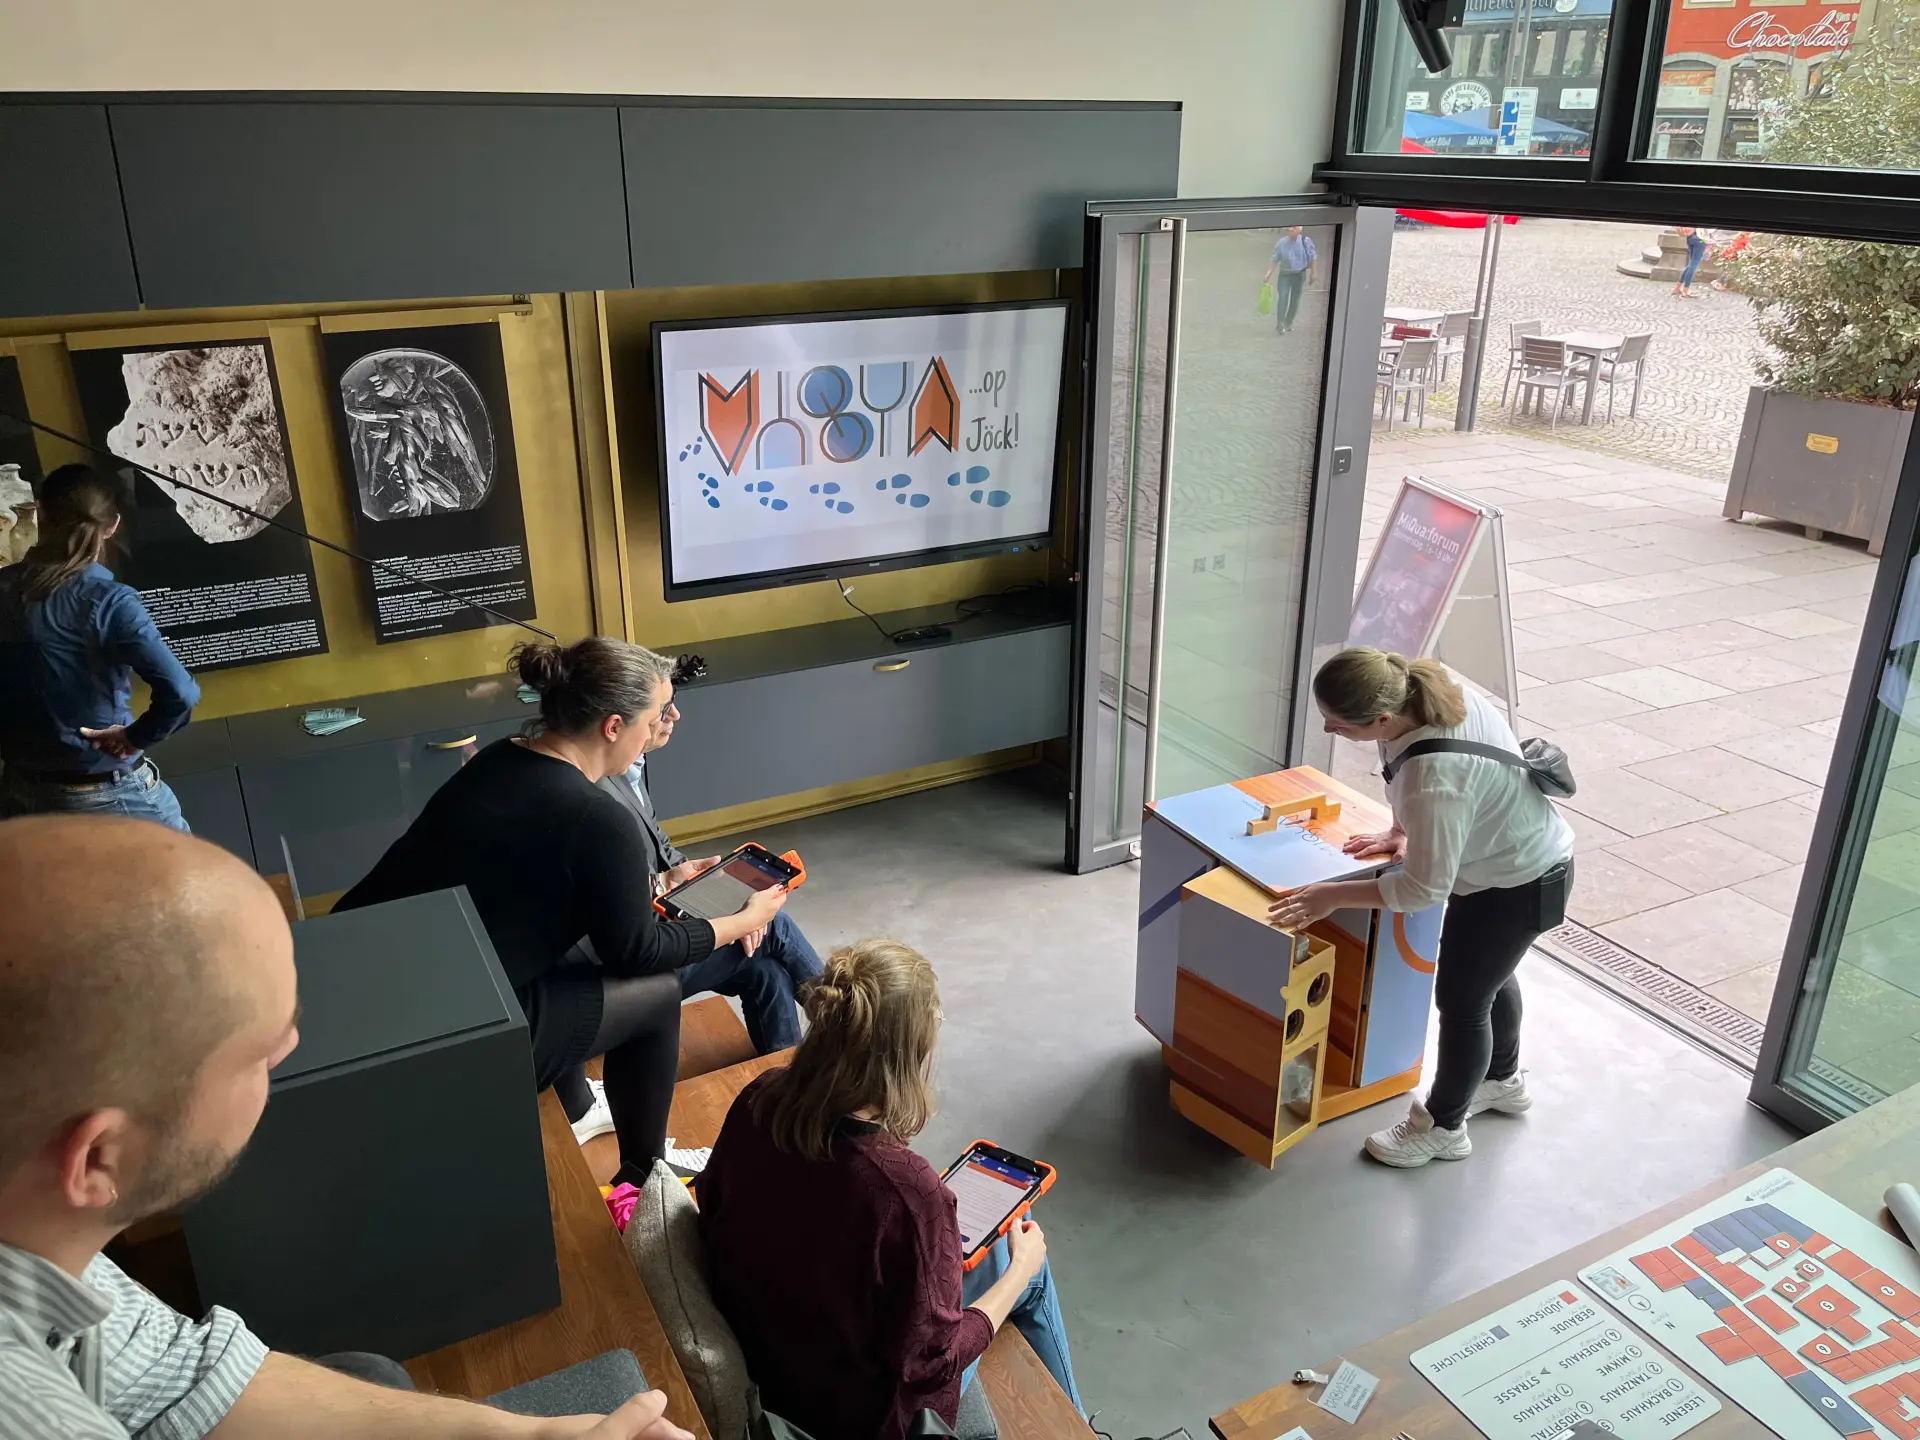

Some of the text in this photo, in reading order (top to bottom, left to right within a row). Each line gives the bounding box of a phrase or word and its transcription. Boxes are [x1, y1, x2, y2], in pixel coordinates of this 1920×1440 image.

[966, 412, 1019, 453] Jöck!
[1517, 1300, 1563, 1328] JÜDISCHE
[1550, 1308, 1595, 1335] GEBÄUDE
[1665, 1320, 1675, 1329] N
[1430, 1335, 1495, 1372] CHRISTLICHE
[1558, 1338, 1610, 1369] BADEHAUS
[1596, 1354, 1630, 1376] MIKWE
[1493, 1375, 1540, 1405] STRASSE
[1599, 1371, 1651, 1404] TANZHAUS
[1512, 1393, 1562, 1423] RATHAUS
[1620, 1387, 1673, 1421] BACKHAUS
[1658, 1395, 1705, 1426] LEGENDE
[1531, 1410, 1581, 1440] HOSPITAL
